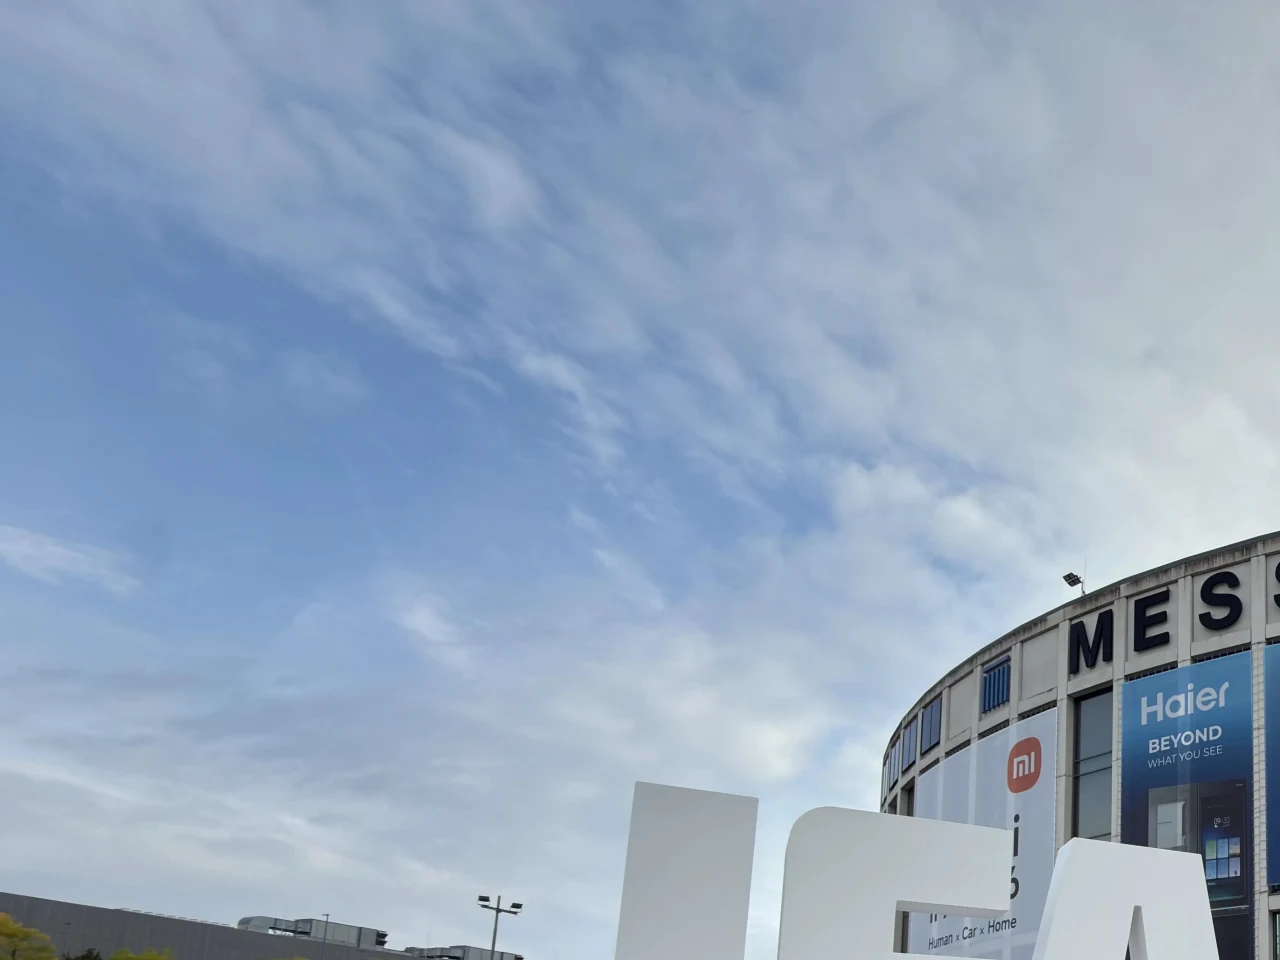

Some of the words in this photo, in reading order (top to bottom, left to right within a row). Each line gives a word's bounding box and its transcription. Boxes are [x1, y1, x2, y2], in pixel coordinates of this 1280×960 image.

[1141, 681, 1229, 726] Haier
[1148, 725, 1222, 754] BEYOND
[1147, 753, 1177, 769] WHAT
[1178, 749, 1201, 762] YOU
[1203, 745, 1223, 757] SEE
[928, 934, 953, 950] Human
[962, 926, 978, 940] Car
[988, 917, 1017, 934] Home
